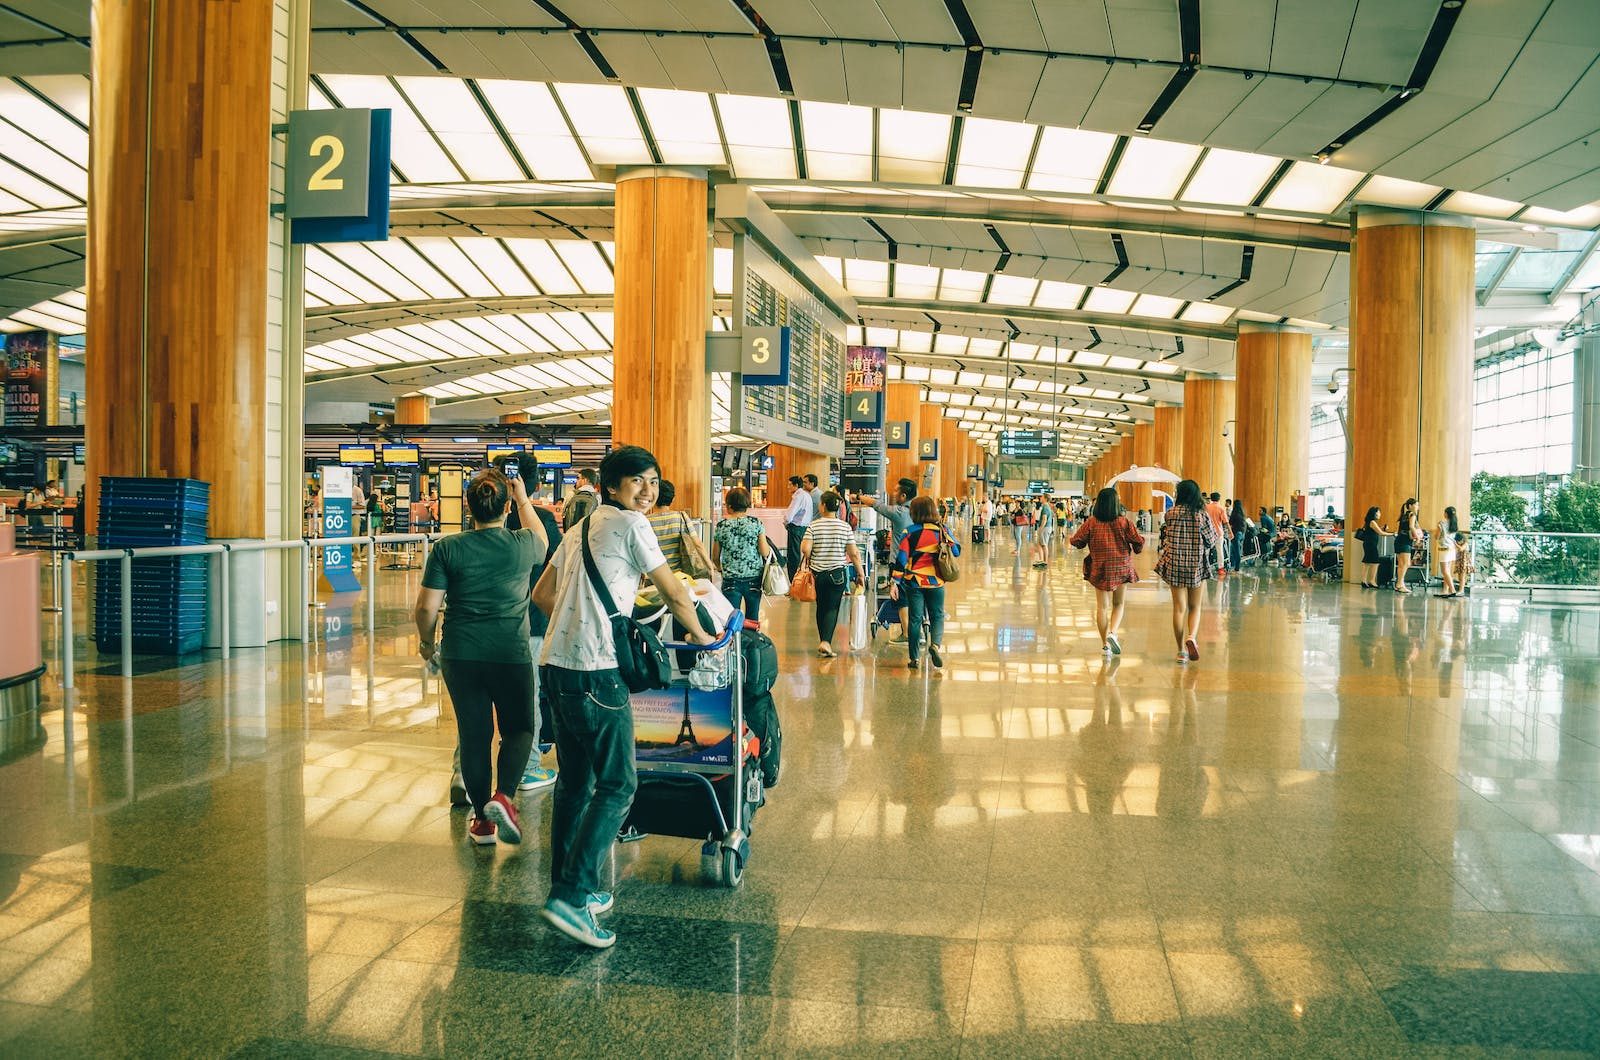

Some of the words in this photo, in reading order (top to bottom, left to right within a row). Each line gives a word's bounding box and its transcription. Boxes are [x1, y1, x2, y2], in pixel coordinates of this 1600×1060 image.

[308, 135, 345, 191] 2
[751, 337, 770, 364] 3
[857, 398, 870, 415] 4
[892, 426, 901, 440] 5
[923, 443, 931, 453] 6
[763, 457, 773, 468] 4
[326, 515, 343, 529] 60
[326, 551, 341, 565] 10
